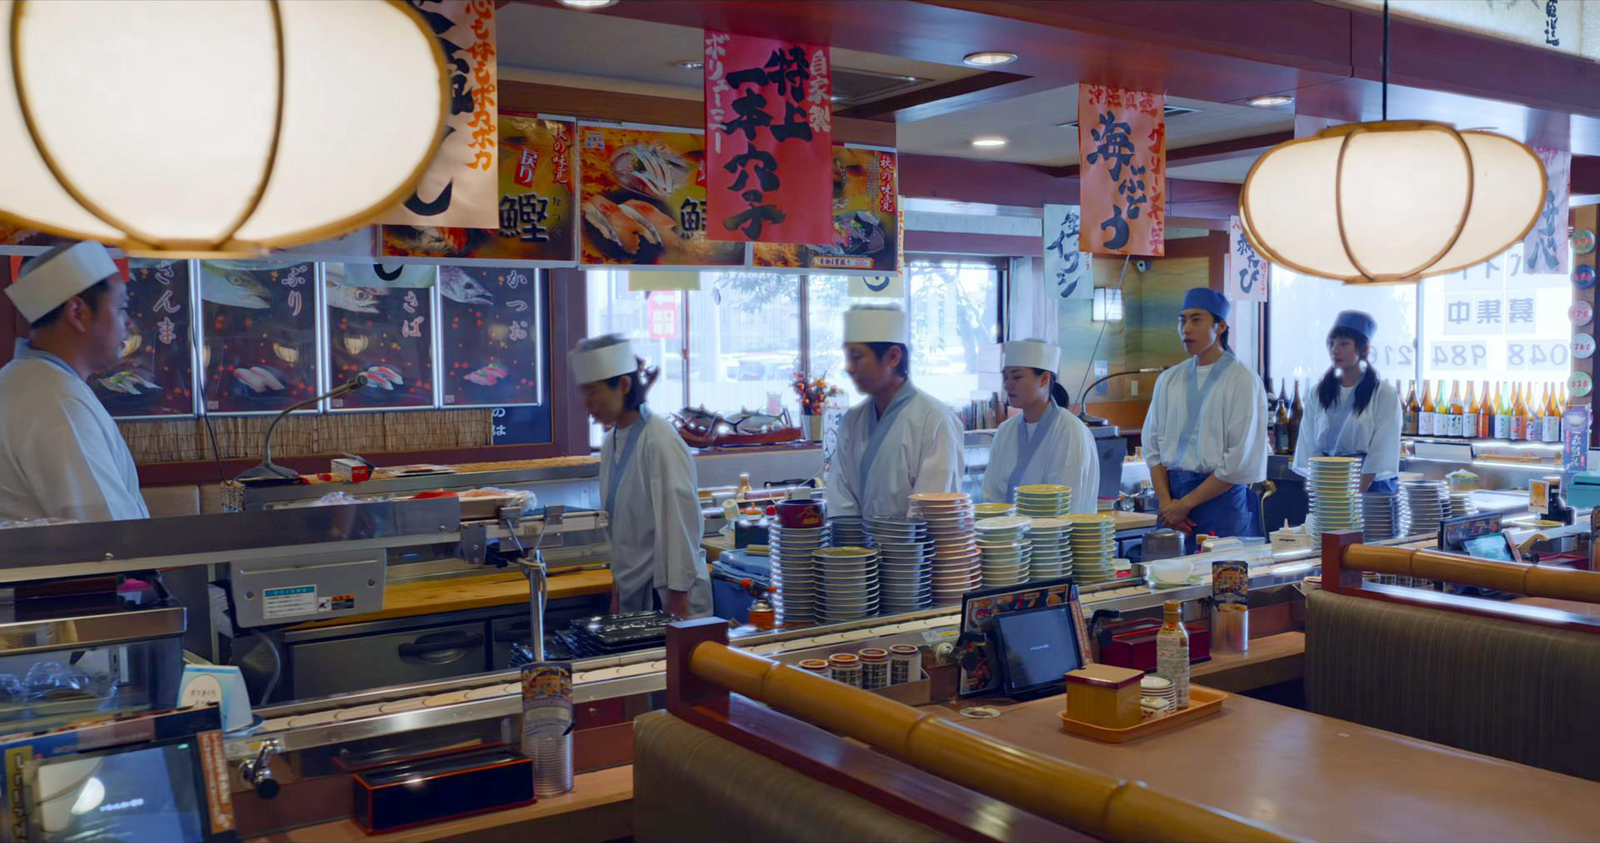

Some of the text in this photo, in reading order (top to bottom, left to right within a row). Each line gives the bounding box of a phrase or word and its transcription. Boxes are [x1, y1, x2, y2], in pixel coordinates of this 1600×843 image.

[705, 33, 730, 154] ボリューミー
[764, 46, 814, 142] 特上
[807, 49, 832, 133] 自家製
[551, 124, 569, 185] 秋の味覚
[722, 67, 787, 240] 一本穴子
[879, 155, 894, 213] 秋の味覚
[1086, 110, 1148, 250] 海ぶどう
[500, 193, 549, 243] 鰹
[153, 260, 181, 345] さんま
[281, 265, 307, 317] ぶり
[402, 290, 424, 338] さば
[506, 269, 528, 341] かつお
